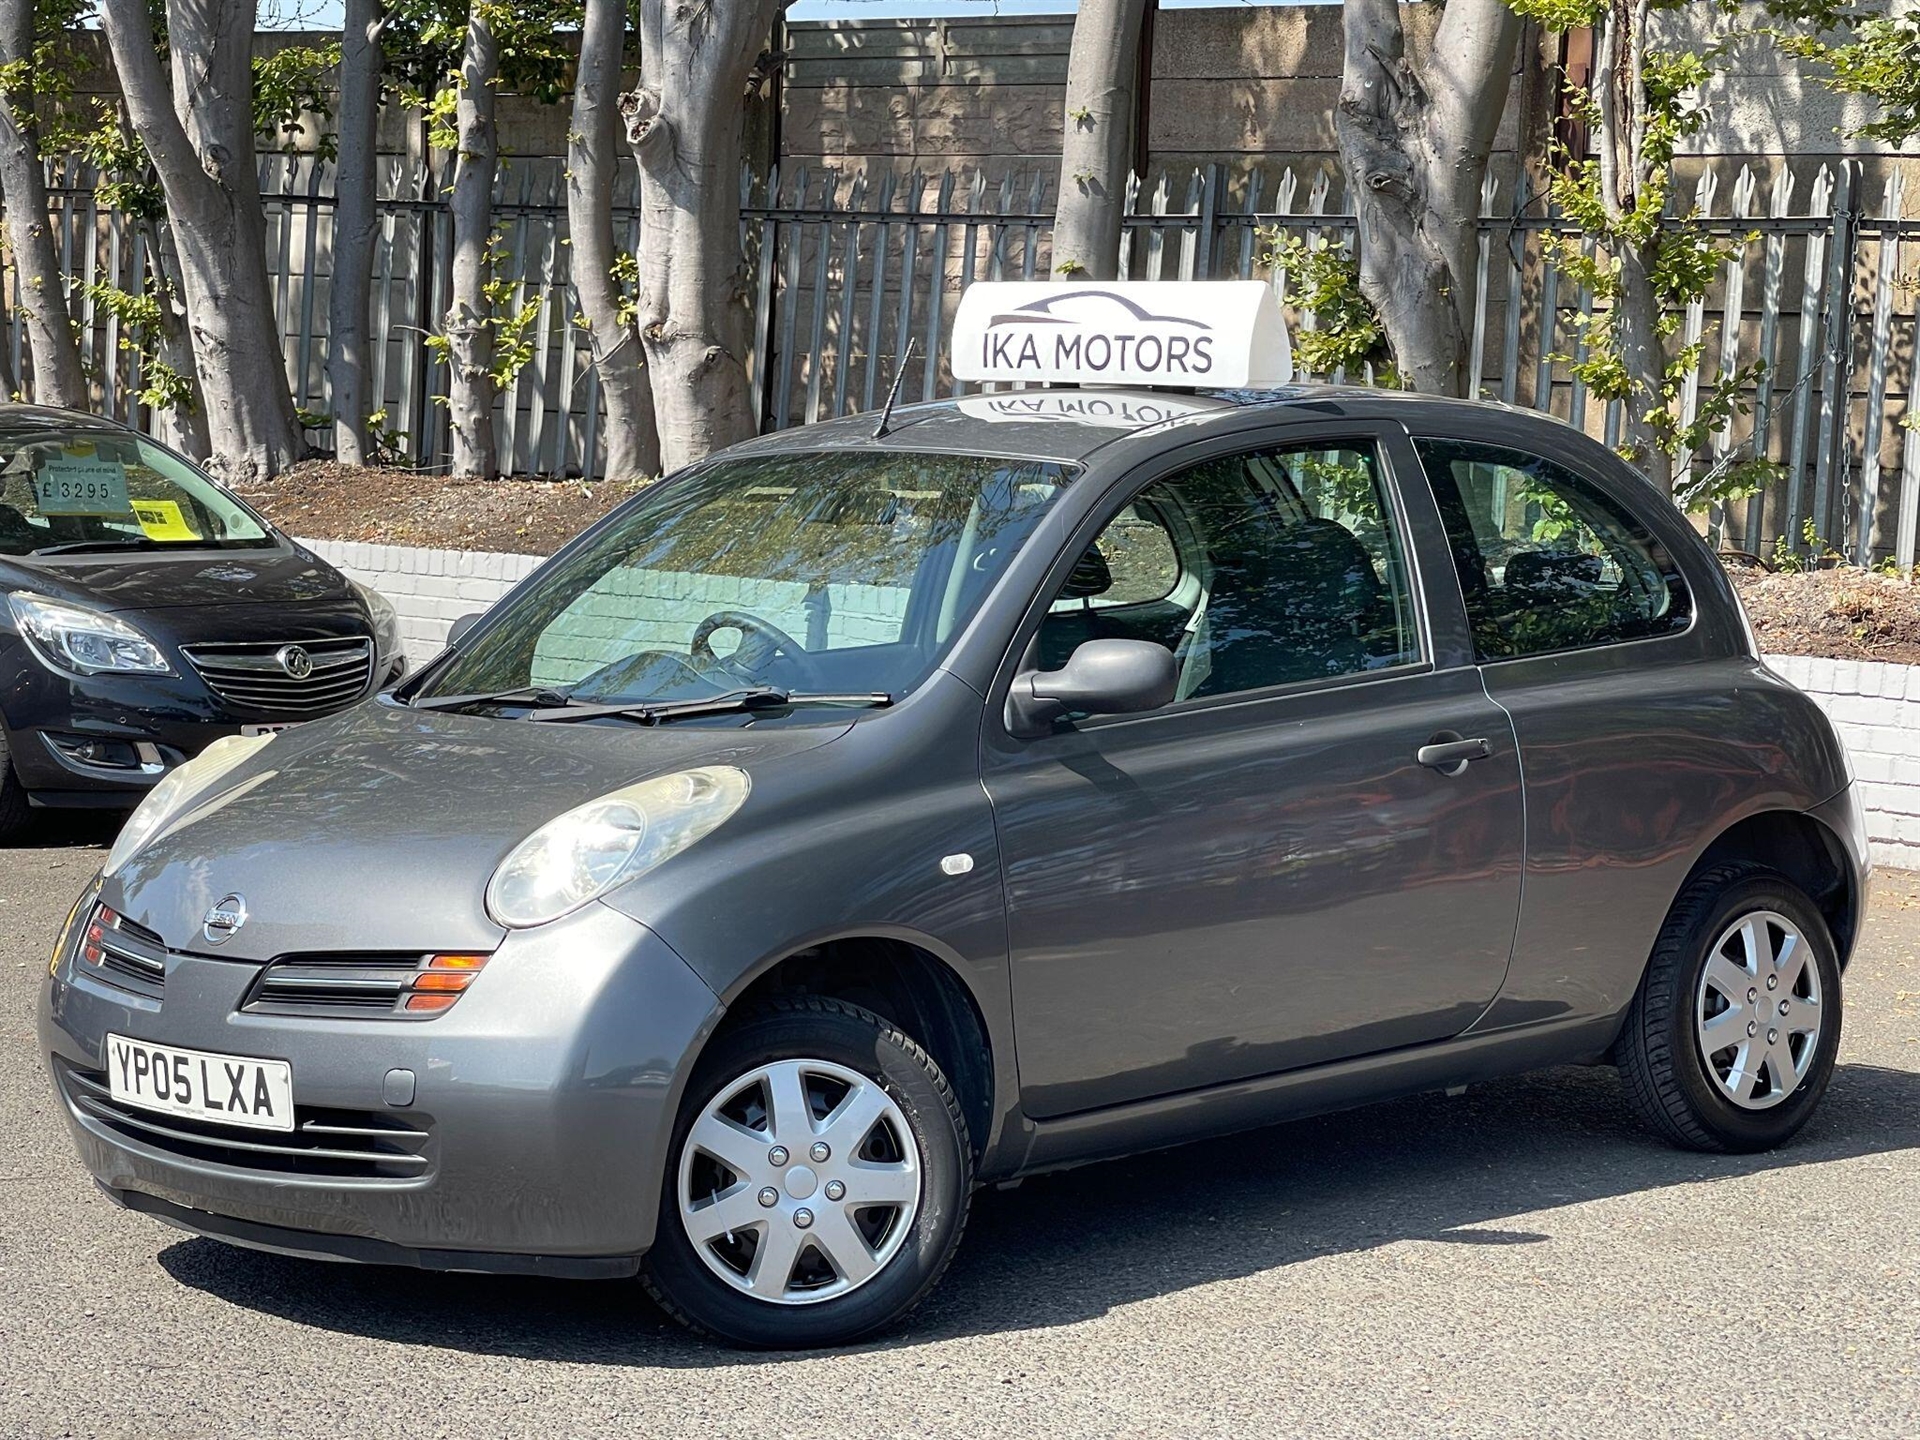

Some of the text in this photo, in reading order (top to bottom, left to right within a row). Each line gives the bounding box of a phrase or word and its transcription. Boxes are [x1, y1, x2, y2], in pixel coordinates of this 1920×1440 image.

[982, 332, 1214, 375] IKA MOTORS
[61, 482, 109, 499] 3295
[116, 1042, 275, 1118] YP05 LXA
